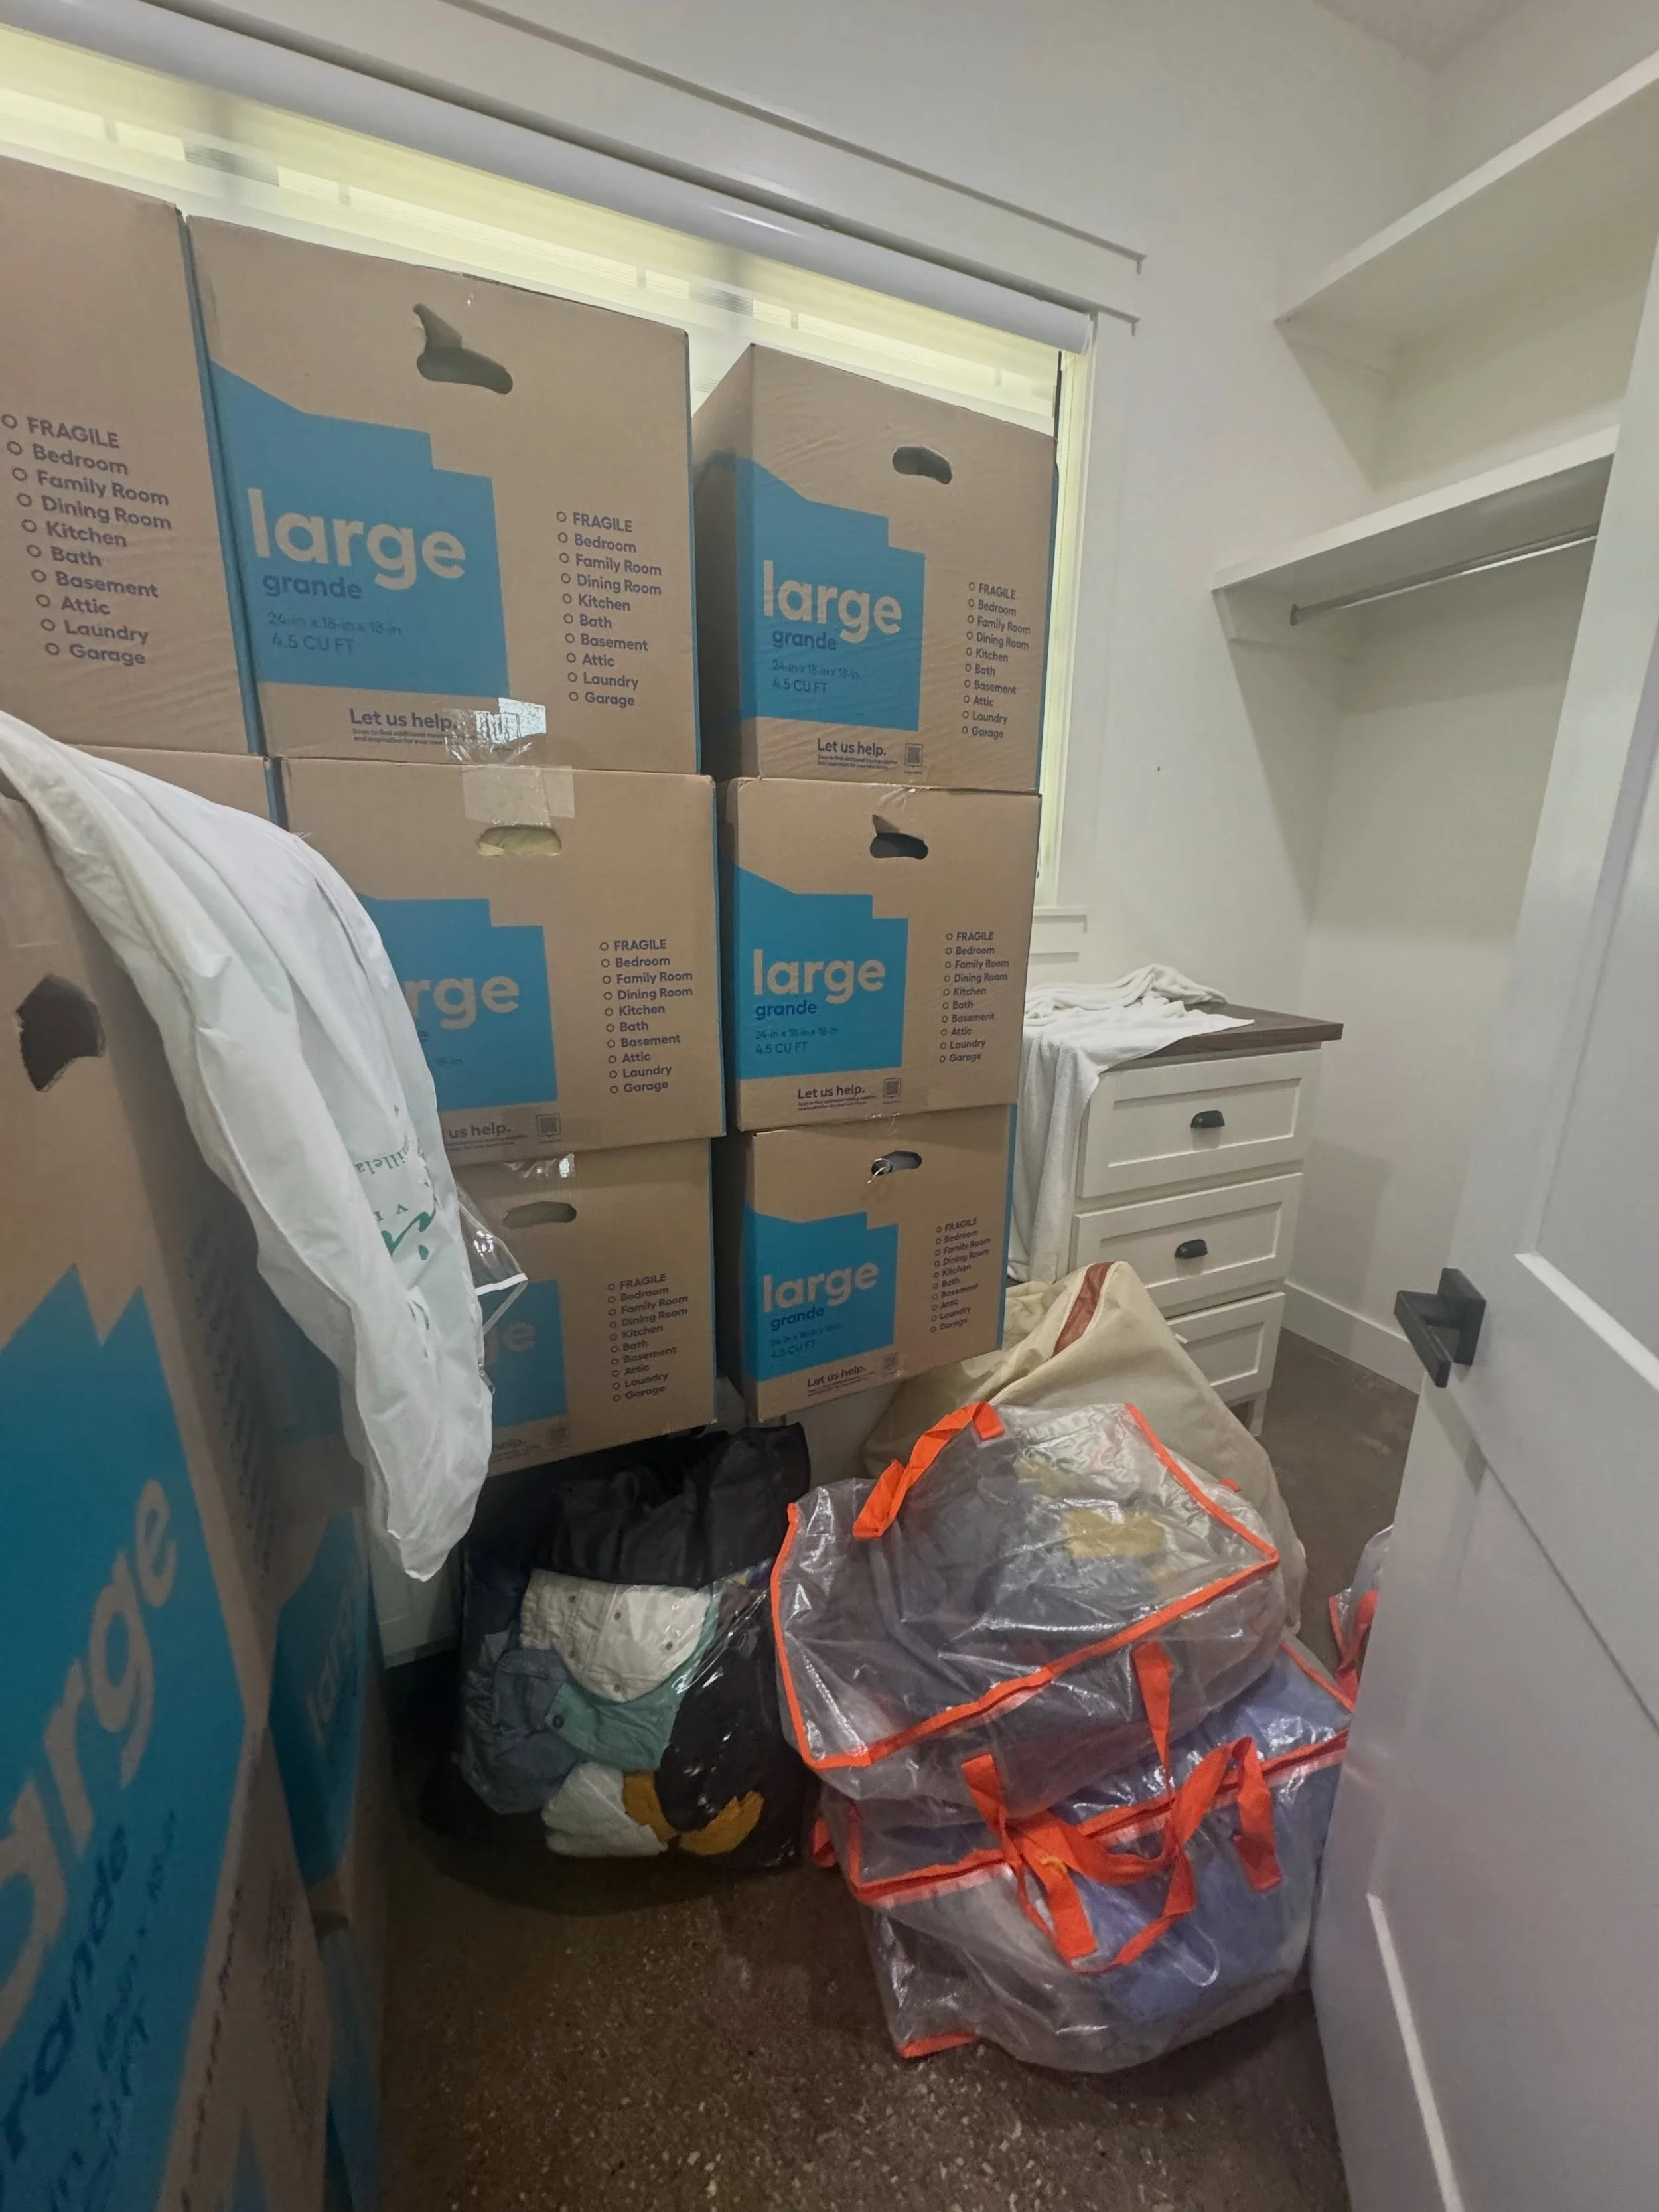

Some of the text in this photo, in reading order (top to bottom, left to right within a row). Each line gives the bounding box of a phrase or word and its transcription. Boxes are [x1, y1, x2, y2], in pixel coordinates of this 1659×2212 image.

[27, 416, 120, 449] FRAGILE
[33, 443, 128, 475] Bedroom
[37, 469, 169, 506] Family Room
[42, 495, 171, 530] Dining Room
[573, 512, 632, 532] FRAGILE
[46, 520, 127, 547] Kitchen
[248, 488, 466, 590] large
[574, 533, 636, 553] Bedroom
[51, 545, 102, 567] Bath
[575, 553, 662, 576] Family Room
[56, 570, 159, 597] Basement
[262, 575, 362, 599] grande
[577, 573, 662, 595] Dining Room
[979, 583, 1015, 599] FRAGILE
[62, 596, 111, 615] Attic
[578, 594, 630, 611] Kitchen
[763, 559, 902, 644] large
[978, 599, 1017, 616] Bedroom
[580, 614, 612, 628] Bath
[977, 616, 1031, 634] Family Room
[65, 620, 149, 645] Laundry
[303, 635, 329, 651] CU
[334, 638, 354, 654] FT
[581, 633, 649, 652] Basement
[772, 630, 837, 651] grande
[977, 632, 1029, 650] Dining Room
[70, 644, 146, 666] Garage
[582, 653, 615, 667] Attic
[975, 648, 1009, 662] Kitchen
[975, 663, 995, 676] Bath
[583, 672, 639, 690] Laundry
[794, 680, 811, 692] CU
[814, 682, 828, 694] FT
[974, 679, 1017, 694] Basement
[585, 691, 635, 708] Garage
[974, 695, 994, 707] Attic
[350, 708, 458, 732] Let us help.
[972, 710, 1008, 725] Laundry
[972, 725, 1003, 740] Garage
[817, 738, 887, 757] Let us help.
[956, 932, 994, 941] FRAGILE
[614, 939, 667, 951] FRAGILE
[956, 946, 995, 956] Bedroom
[615, 956, 671, 968] Bedroom
[955, 960, 1009, 970] Family Room
[616, 972, 693, 984] Family Room
[753, 948, 886, 1004] large
[954, 973, 1008, 984] Dining Room
[618, 987, 693, 1001] Dining Room
[953, 987, 986, 996] Kitchen
[403, 975, 520, 1031] rge
[619, 1005, 666, 1016] Kitchen
[755, 999, 818, 1021] grande
[952, 1000, 974, 1009] Bath
[952, 1013, 995, 1023] Basement
[620, 1021, 649, 1032] Bath
[950, 1026, 972, 1036] Attic
[620, 1034, 681, 1048] Basement
[755, 1041, 809, 1054] 4.5 CU FT
[950, 1039, 986, 1050] Laundry
[622, 1051, 651, 1063] Attic
[949, 1053, 981, 1063] Garage
[623, 1065, 672, 1078] Laundry
[623, 1080, 669, 1093] Garage
[798, 1084, 865, 1099] Let us help.
[449, 1122, 511, 1138] us help.
[944, 1217, 978, 1232] FRAGILE
[944, 1229, 978, 1243] Bedroom
[943, 1238, 991, 1254] Family Room
[943, 1248, 989, 1266] Dining Room
[942, 1264, 972, 1277] Kitchen
[620, 1273, 666, 1290] FRAGILE
[763, 1262, 879, 1313] large
[941, 1277, 960, 1288] Bath
[620, 1287, 669, 1302] Bedroom
[941, 1282, 979, 1299] Basement
[621, 1295, 689, 1315] Family Room
[940, 1298, 959, 1309] Attic
[622, 1308, 688, 1327] Dining Room
[771, 1306, 825, 1331] grande
[940, 1306, 972, 1320] Laundry
[622, 1325, 664, 1339] Kitchen
[939, 1318, 968, 1331] Garage
[622, 1339, 648, 1351] Bath
[623, 1347, 677, 1364] Basement
[624, 1364, 650, 1376] Attic
[624, 1372, 669, 1388] Laundry
[807, 1376, 825, 1387] Let
[826, 1372, 839, 1382] us
[625, 1386, 667, 1400] Garage
